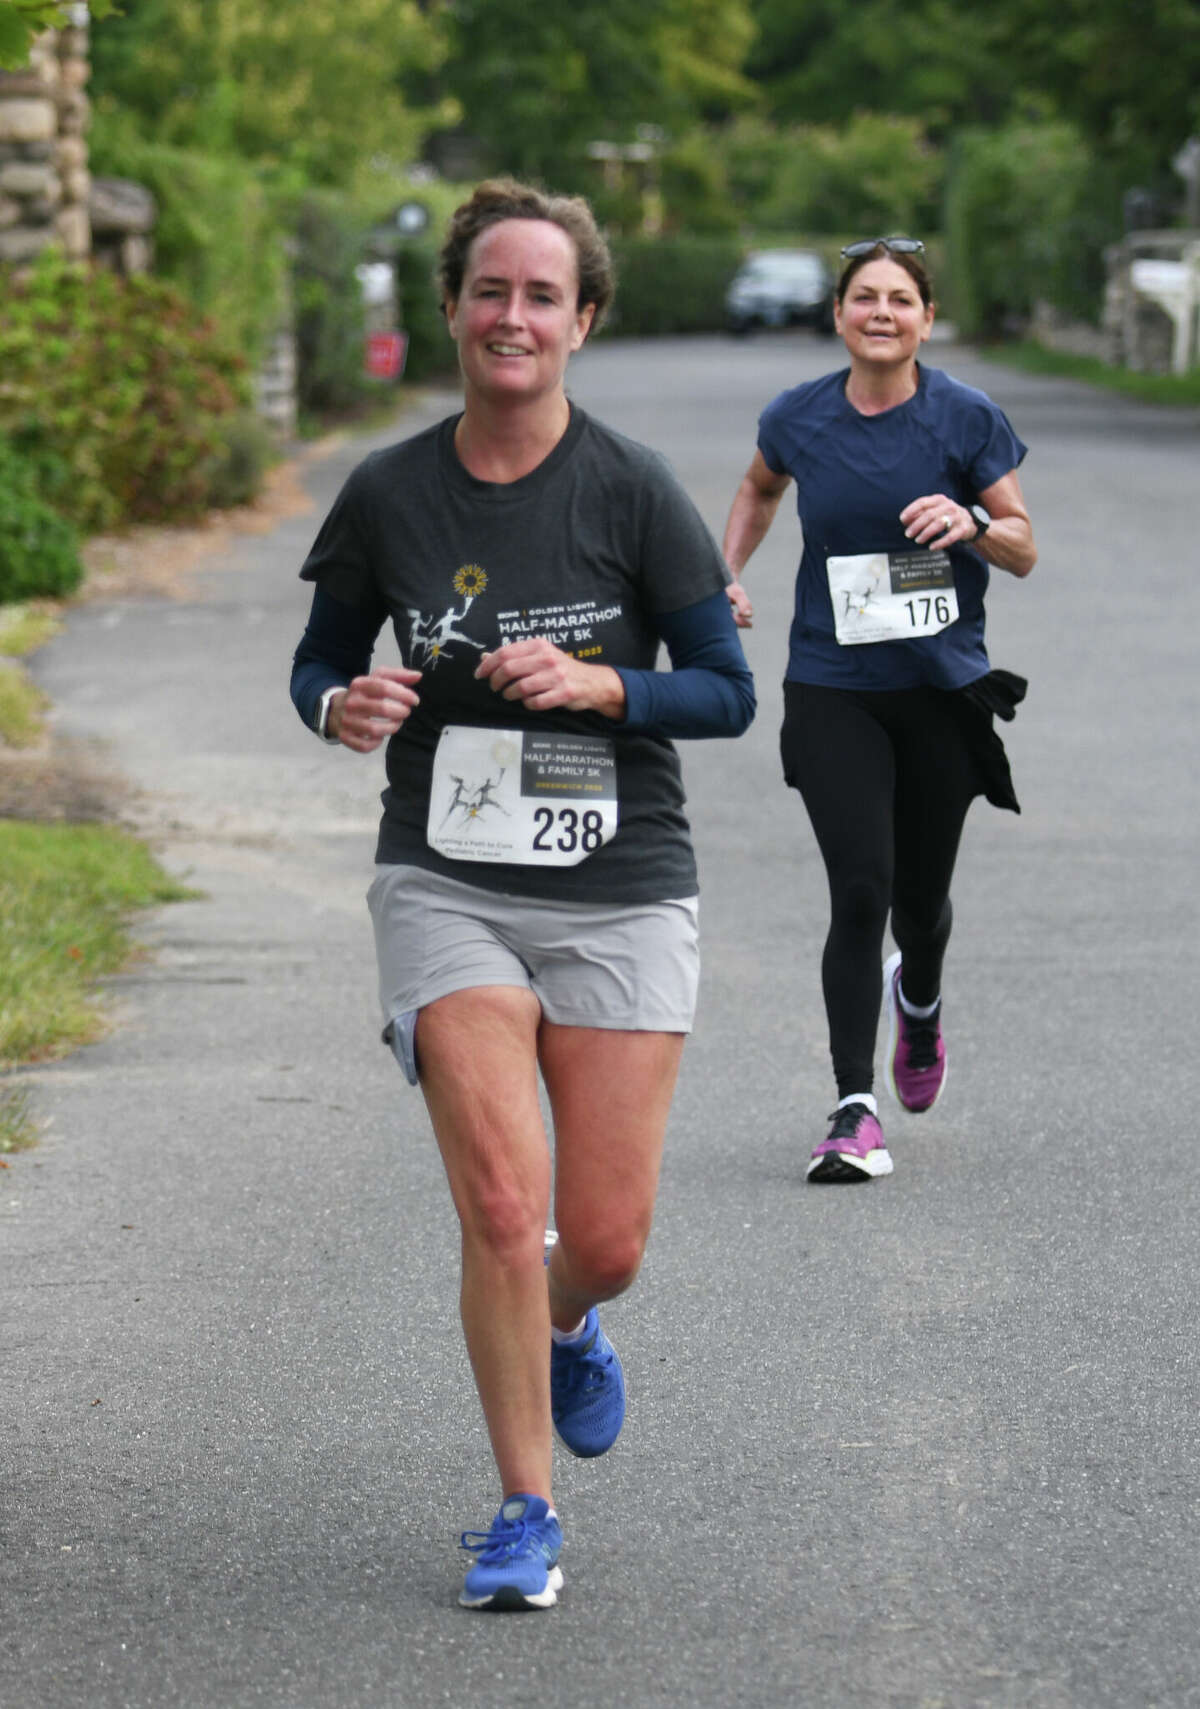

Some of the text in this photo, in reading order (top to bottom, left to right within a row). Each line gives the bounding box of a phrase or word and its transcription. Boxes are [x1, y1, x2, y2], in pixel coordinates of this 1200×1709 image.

[528, 605, 565, 616] GOLDEN
[566, 601, 596, 612] LIGHTS
[904, 596, 950, 627] 176
[499, 605, 622, 633] HALF-MARATHON
[502, 636, 511, 648] &
[573, 628, 592, 642] 5K
[524, 752, 615, 768] HALF-MARATHON
[537, 765, 601, 777] & FAMILY 5K
[532, 807, 603, 853] 238
